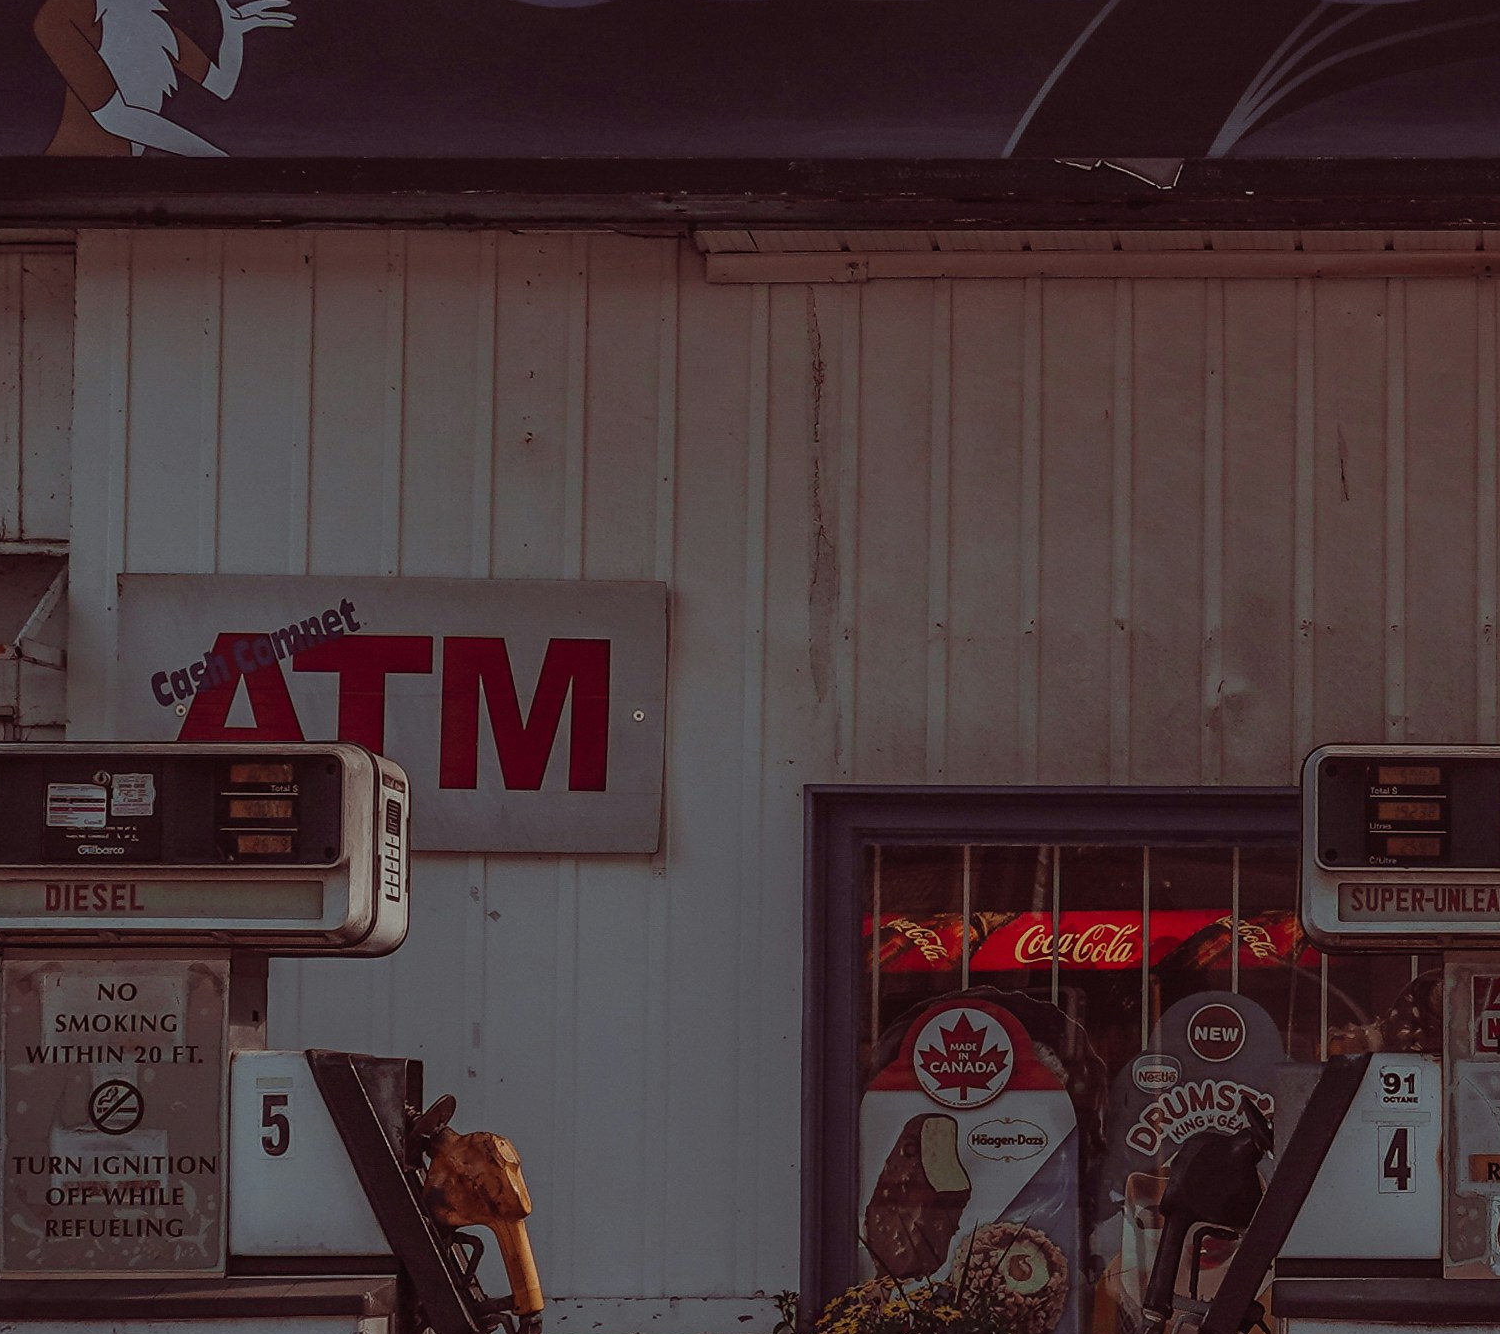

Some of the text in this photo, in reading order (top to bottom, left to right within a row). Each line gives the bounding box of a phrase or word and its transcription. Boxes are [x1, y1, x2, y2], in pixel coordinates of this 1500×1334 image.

[151, 651, 231, 707] Cash
[177, 632, 611, 791] ATM
[270, 784, 292, 792] Total
[1370, 786, 1390, 795] Total
[1369, 822, 1393, 831] Litres
[44, 883, 145, 912] DIESEL
[1014, 923, 1142, 965] Coca-Cola
[97, 982, 138, 1002] NO
[55, 1013, 178, 1033] SMOKING
[1194, 1025, 1240, 1042] NEW
[25, 1045, 203, 1064] WITHIN 20 FT.
[950, 1042, 977, 1052] MADE
[958, 1052, 970, 1061] IN
[929, 1061, 998, 1074] CANADA
[1383, 1072, 1415, 1095] 91
[1382, 1096, 1419, 1104] OCTANE
[261, 1094, 291, 1158] 5
[1130, 1083, 1275, 1152] DRUMST
[1171, 1115, 1205, 1140] KING
[1217, 1114, 1244, 1131] GÉA
[971, 1134, 1044, 1149] Häagen-Dazs
[12, 1155, 217, 1175] TURN IGNITION
[1383, 1128, 1412, 1191] 4
[45, 1187, 184, 1206] OFF WHILE
[45, 1218, 184, 1238] REFUELING
